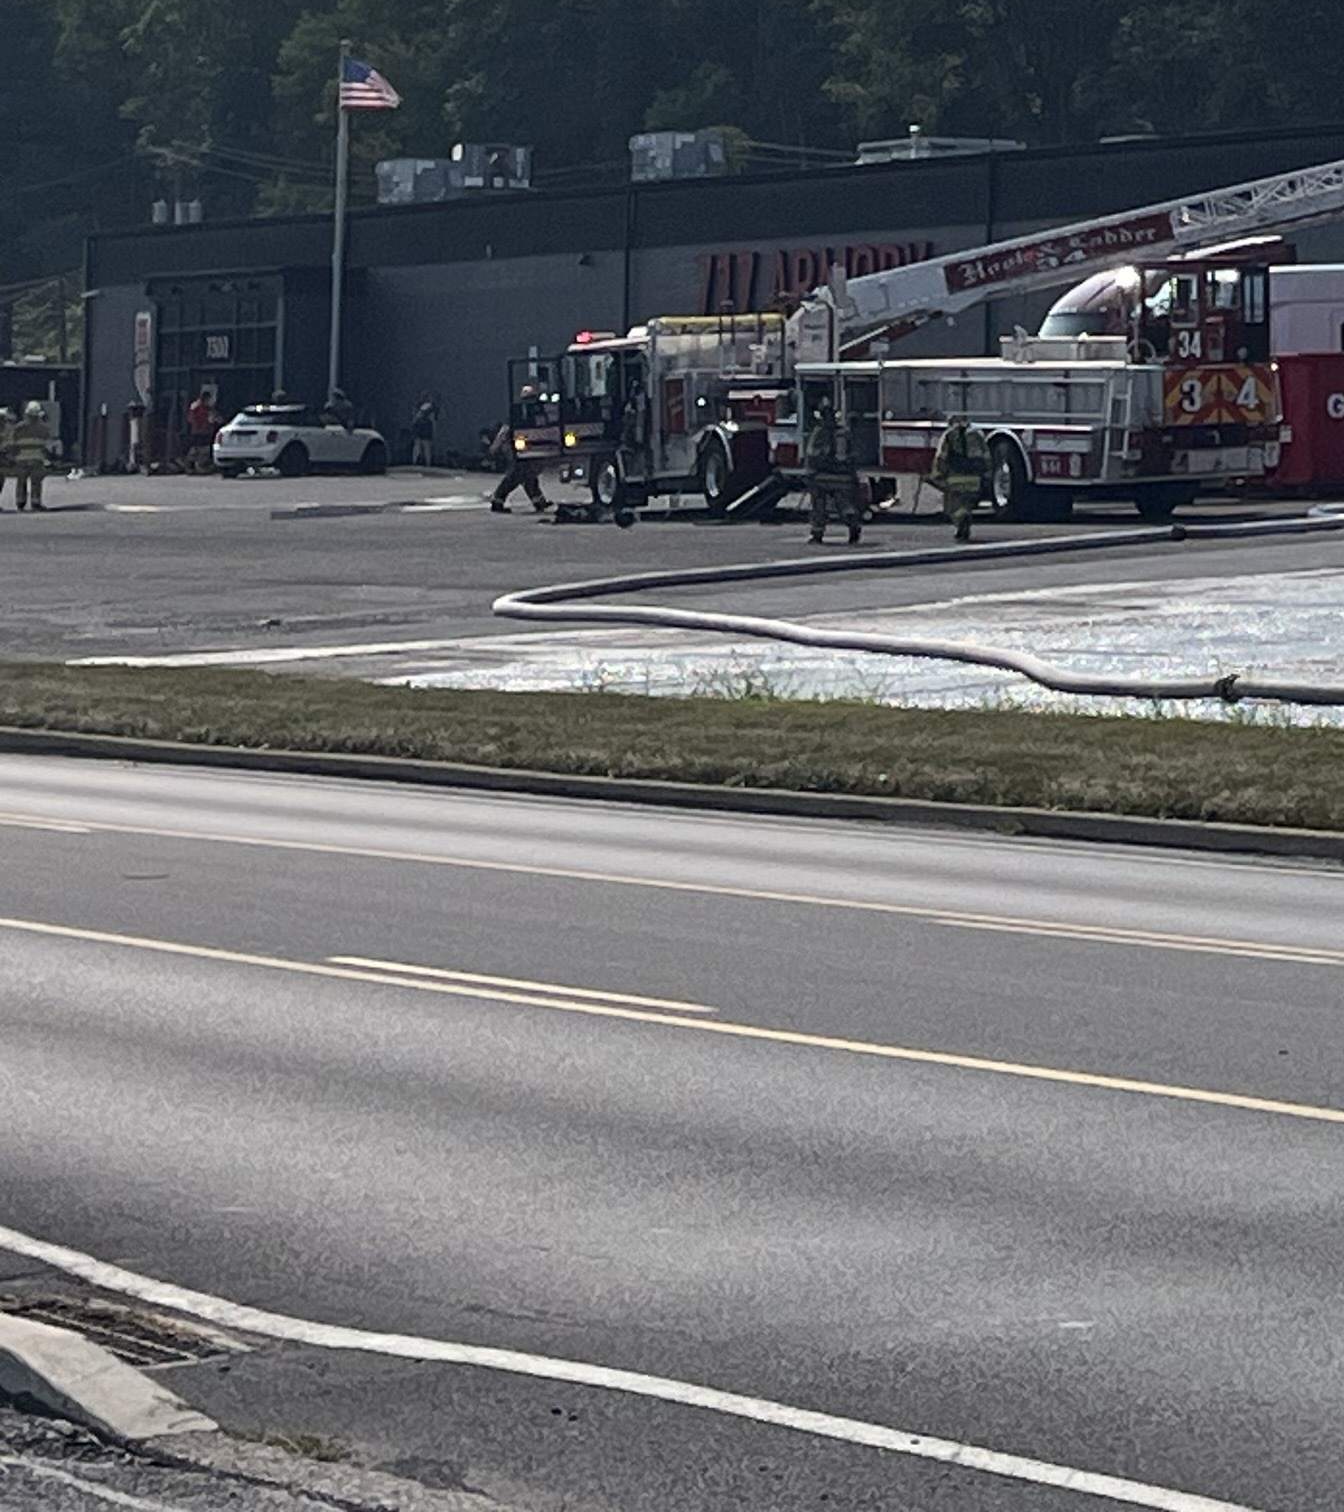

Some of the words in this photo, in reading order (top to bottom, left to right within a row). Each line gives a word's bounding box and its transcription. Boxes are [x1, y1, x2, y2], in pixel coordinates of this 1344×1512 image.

[1178, 331, 1202, 359] 34
[1181, 379, 1203, 413] 3
[1235, 374, 1261, 409] 4
